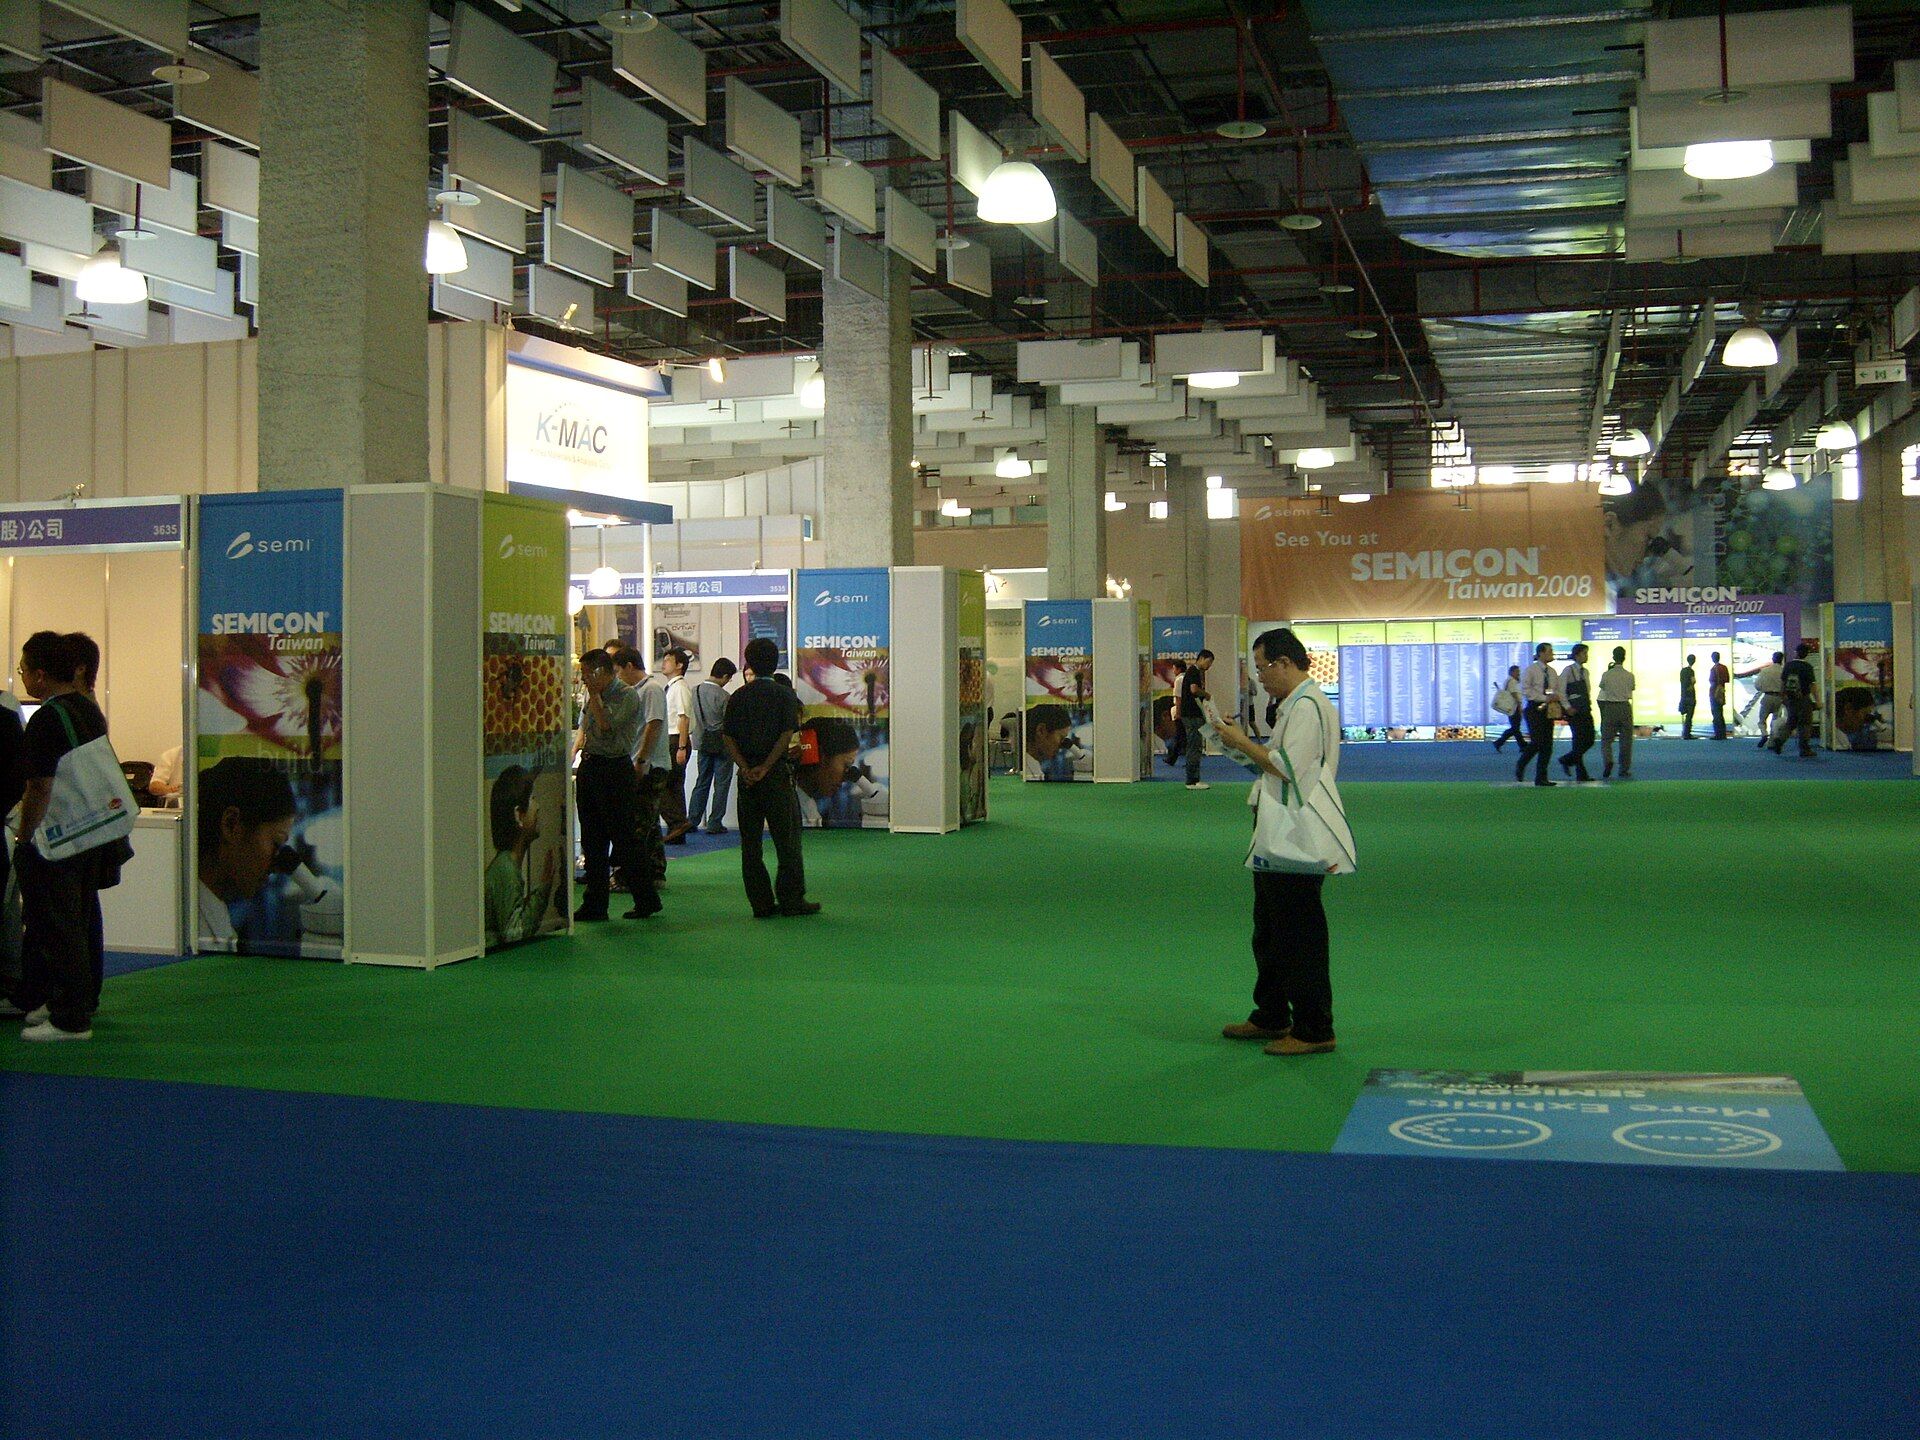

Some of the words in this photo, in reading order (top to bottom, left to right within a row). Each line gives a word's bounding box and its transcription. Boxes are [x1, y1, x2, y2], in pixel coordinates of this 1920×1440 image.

[536, 411, 608, 454] K-MAC
[1275, 508, 1310, 517] semi
[153, 525, 178, 536] 3635
[1275, 531, 1310, 547] See
[1316, 530, 1352, 546] You
[1360, 532, 1379, 545] at
[258, 539, 311, 553] semi
[1351, 547, 1540, 581] SEMICON
[834, 594, 868, 603] semi
[1636, 585, 1737, 604] SEMICON
[211, 611, 325, 635] SEMICON
[489, 611, 555, 636] SEMICON
[267, 633, 324, 651] Taiwan
[523, 634, 556, 651] Taiwan
[804, 635, 878, 649] SEMICON
[840, 648, 876, 658] Taiwan
[1031, 646, 1085, 657] SEMICON
[1442, 1087, 1646, 1098] SEMICON
[1406, 1099, 1610, 1114] Exhibits
[1628, 1103, 1772, 1117] More
